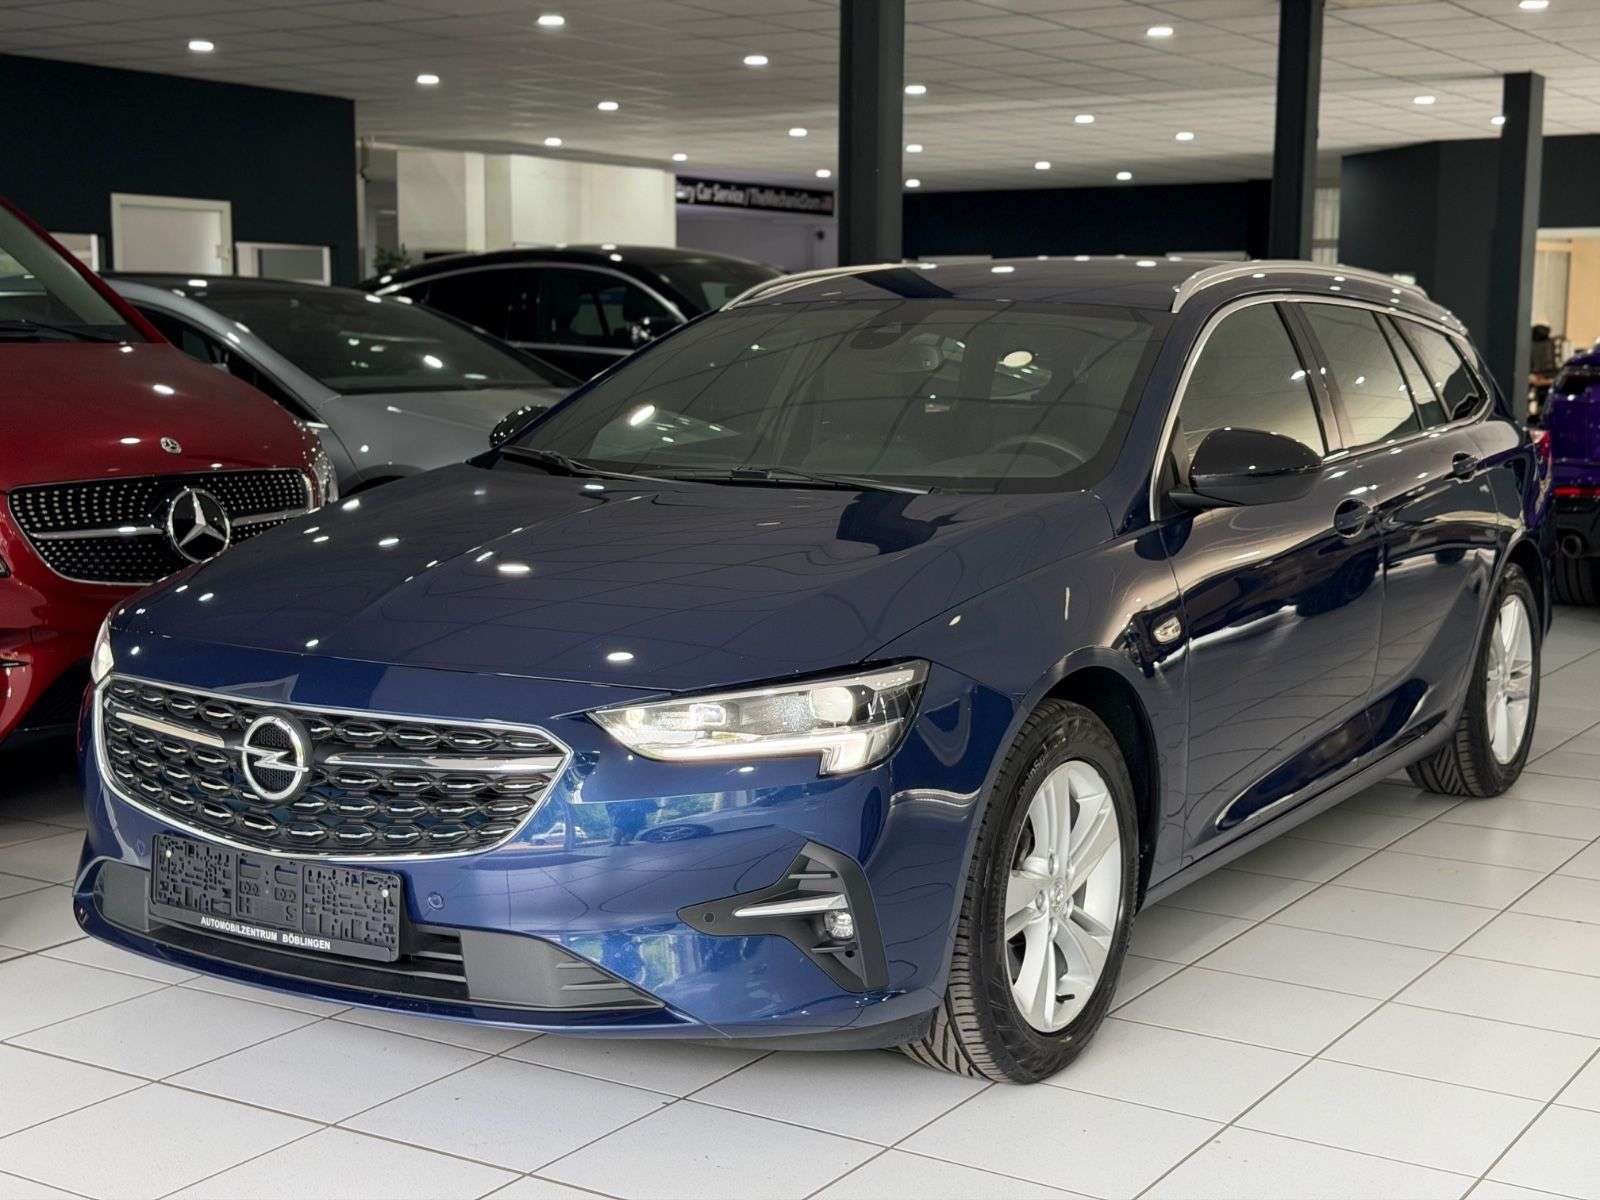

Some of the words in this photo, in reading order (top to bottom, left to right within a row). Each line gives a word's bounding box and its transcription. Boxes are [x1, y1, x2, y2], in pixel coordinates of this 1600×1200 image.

[696, 182, 713, 202] Car
[713, 184, 744, 204] Service
[201, 916, 278, 941] AUTOMOBILZENTRUM
[282, 932, 331, 950] BÖBLINGEN
